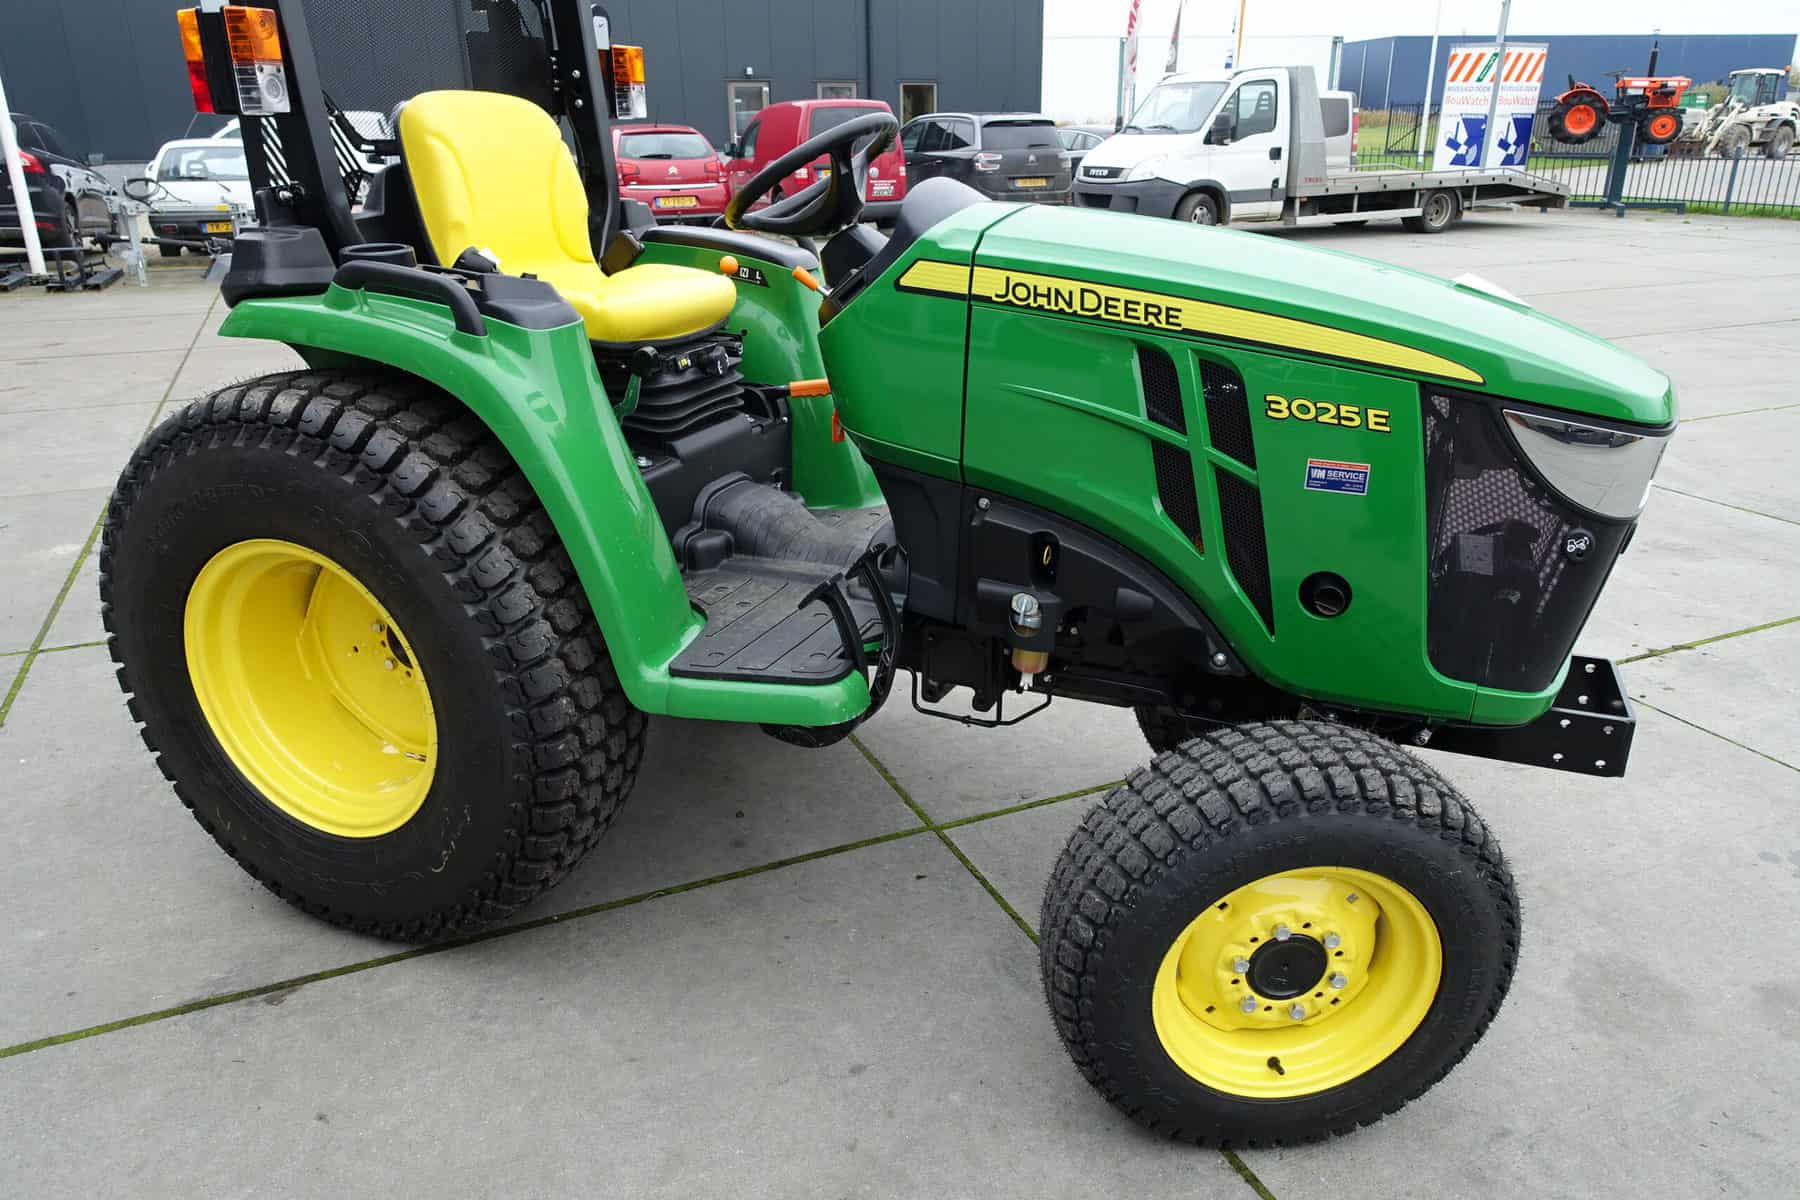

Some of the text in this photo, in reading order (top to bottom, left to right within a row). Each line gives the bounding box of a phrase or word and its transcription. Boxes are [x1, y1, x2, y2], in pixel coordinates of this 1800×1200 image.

[994, 275, 1183, 328] JOHN DEERE
[1265, 394, 1391, 432] 3025 E
[1310, 468, 1326, 479] VM
[1327, 470, 1365, 481] SERVICE
